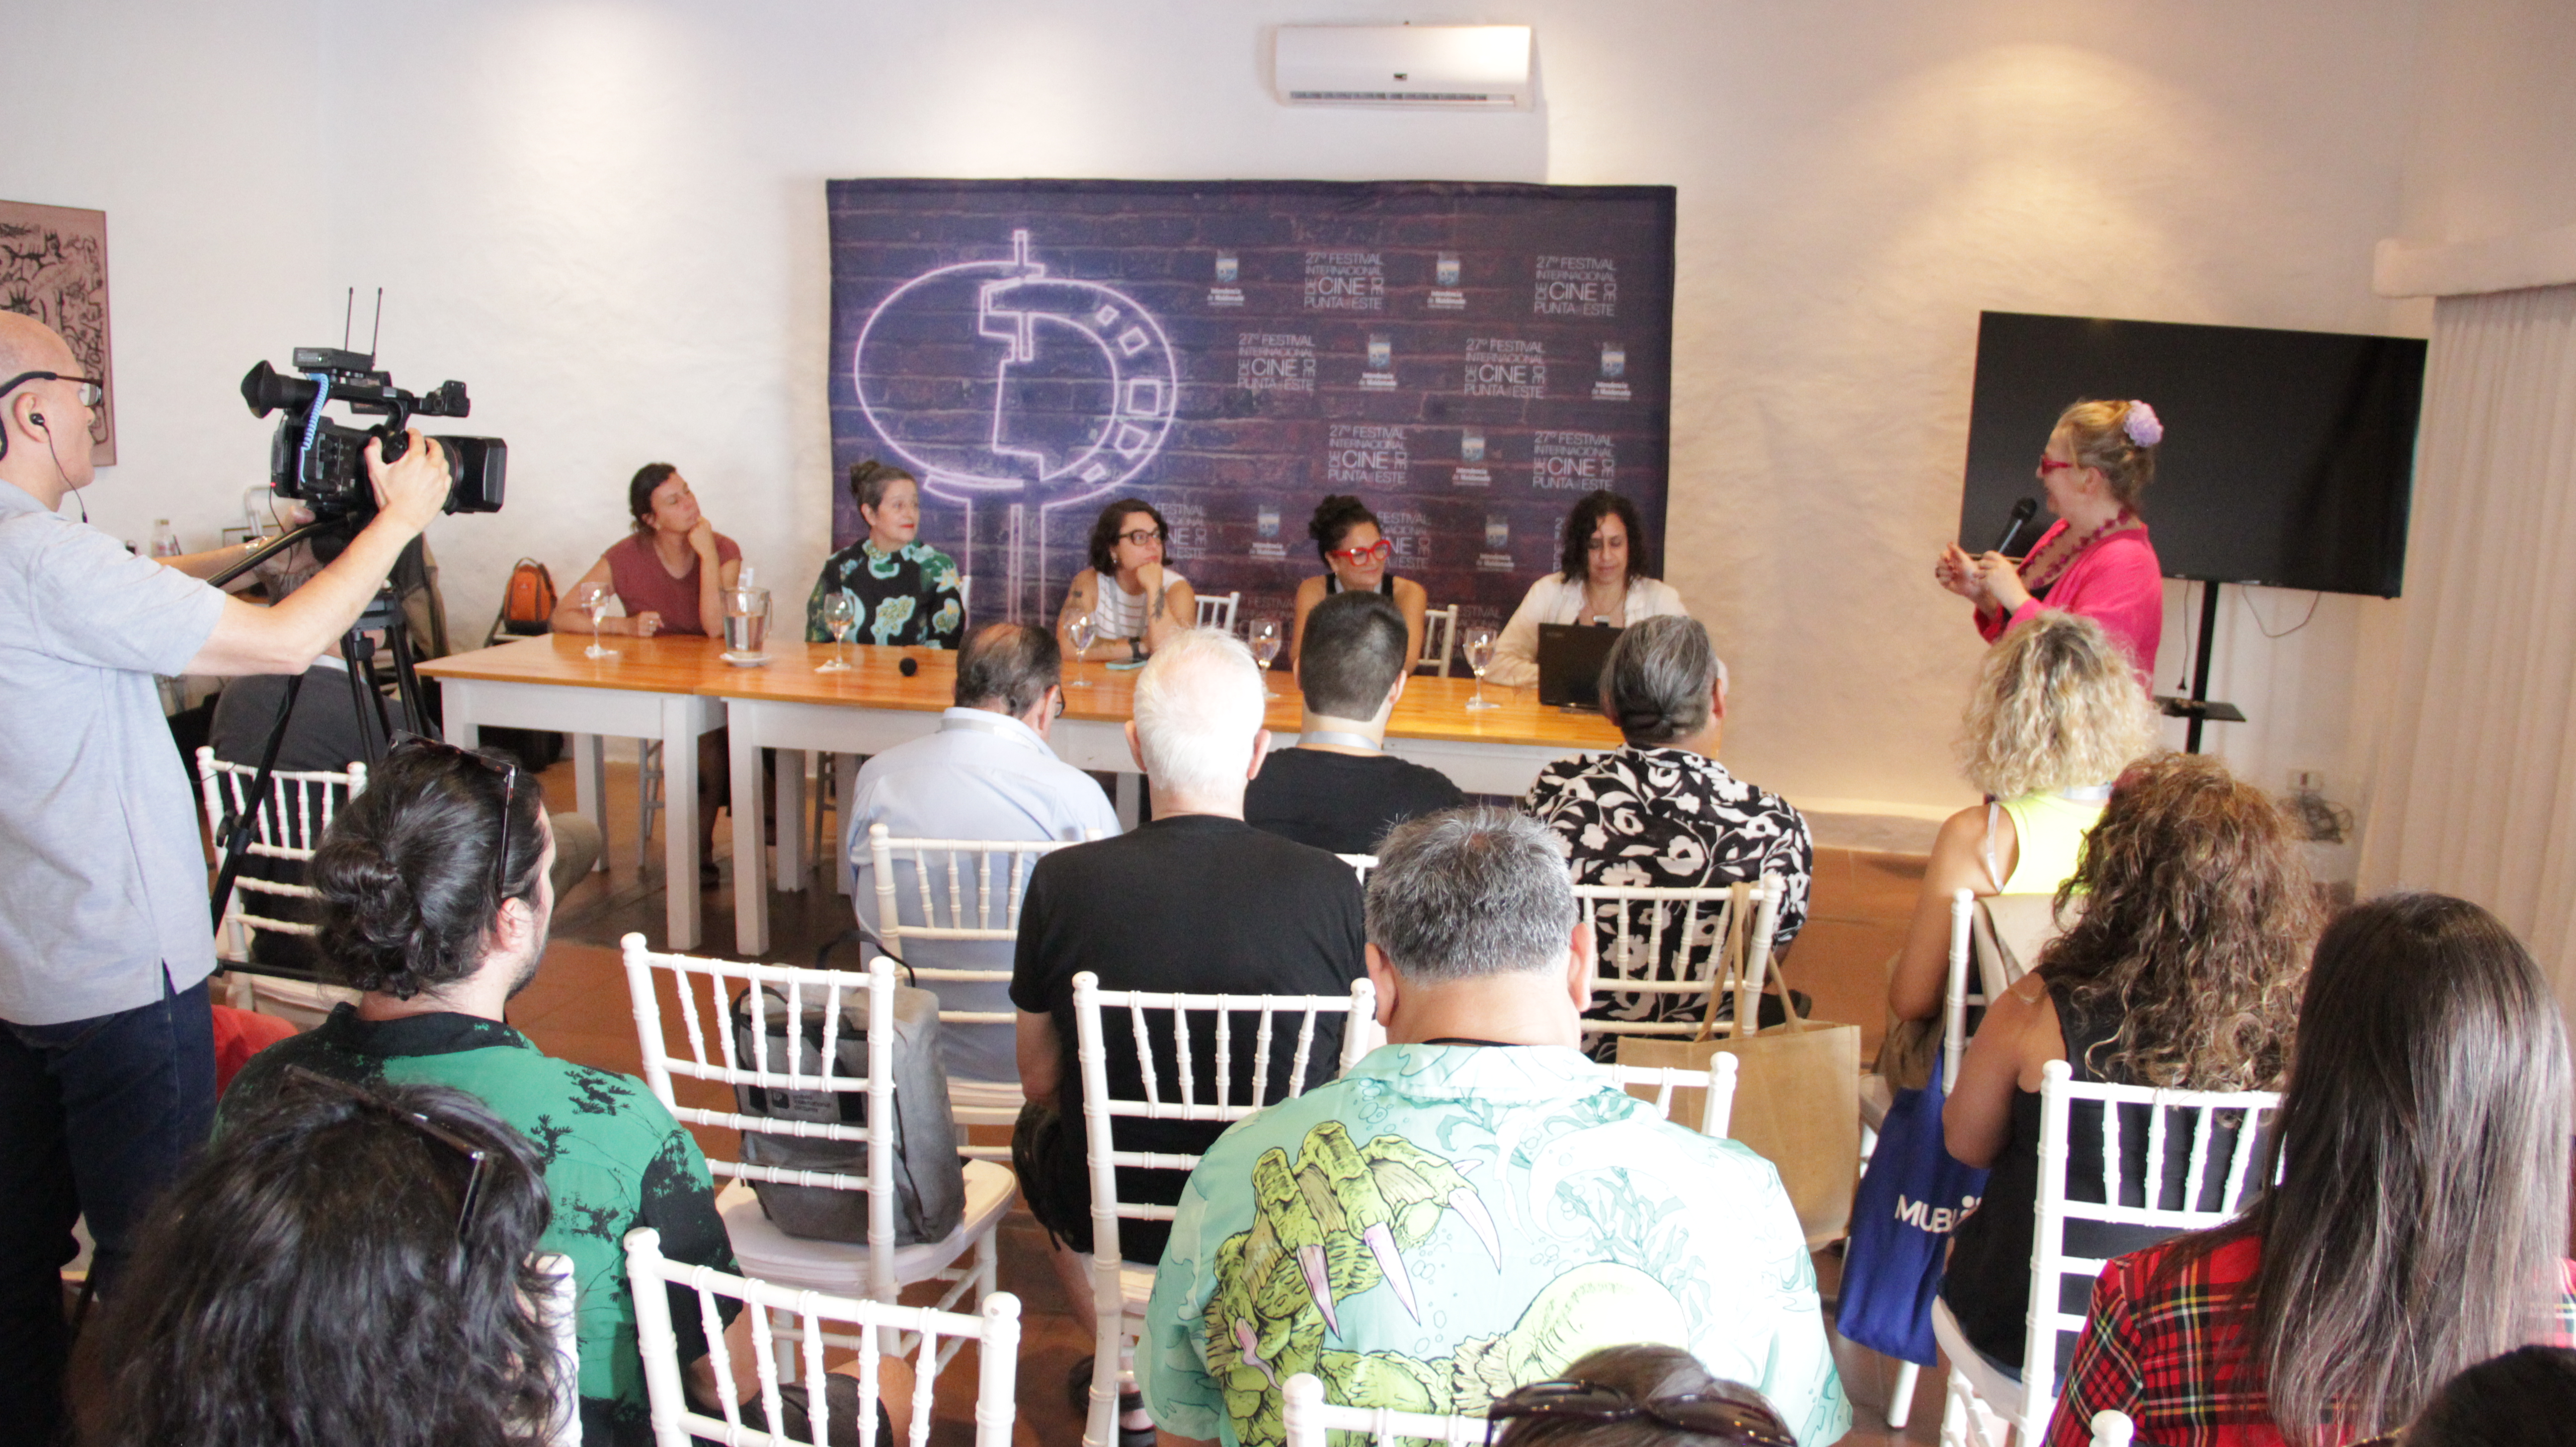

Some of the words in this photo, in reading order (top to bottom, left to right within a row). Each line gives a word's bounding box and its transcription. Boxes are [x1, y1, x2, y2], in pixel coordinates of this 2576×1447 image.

[1329, 253, 1384, 265] FESTIVAL
[1561, 257, 1616, 270] FESTIVAL
[1318, 277, 1366, 295] CINE
[1549, 281, 1597, 301] CINE
[1304, 296, 1344, 308] PUNTA
[1352, 297, 1381, 310] ESTE
[1534, 301, 1575, 314] PUNTA
[1583, 303, 1615, 317] ESTE
[1262, 334, 1315, 347] FESTIVAL
[1490, 339, 1545, 353] FESTIVAL
[1251, 358, 1297, 376] CINE
[1479, 364, 1527, 384] CINE
[1237, 377, 1276, 389] PUNTA
[1284, 378, 1314, 391] ESTE
[1464, 383, 1504, 396] PUNTA
[1513, 386, 1544, 399] ESTE
[1353, 426, 1407, 440] FESTIVAL
[1558, 432, 1614, 446] FESTIVAL
[1342, 450, 1389, 469] CINE
[1547, 457, 1596, 477] CINE
[1328, 470, 1367, 481] PUNTA
[1375, 471, 1407, 484] ESTE
[1532, 476, 1574, 489] PUNTA
[1581, 478, 1613, 491] ESTE
[1177, 547, 1206, 560] ESTE
